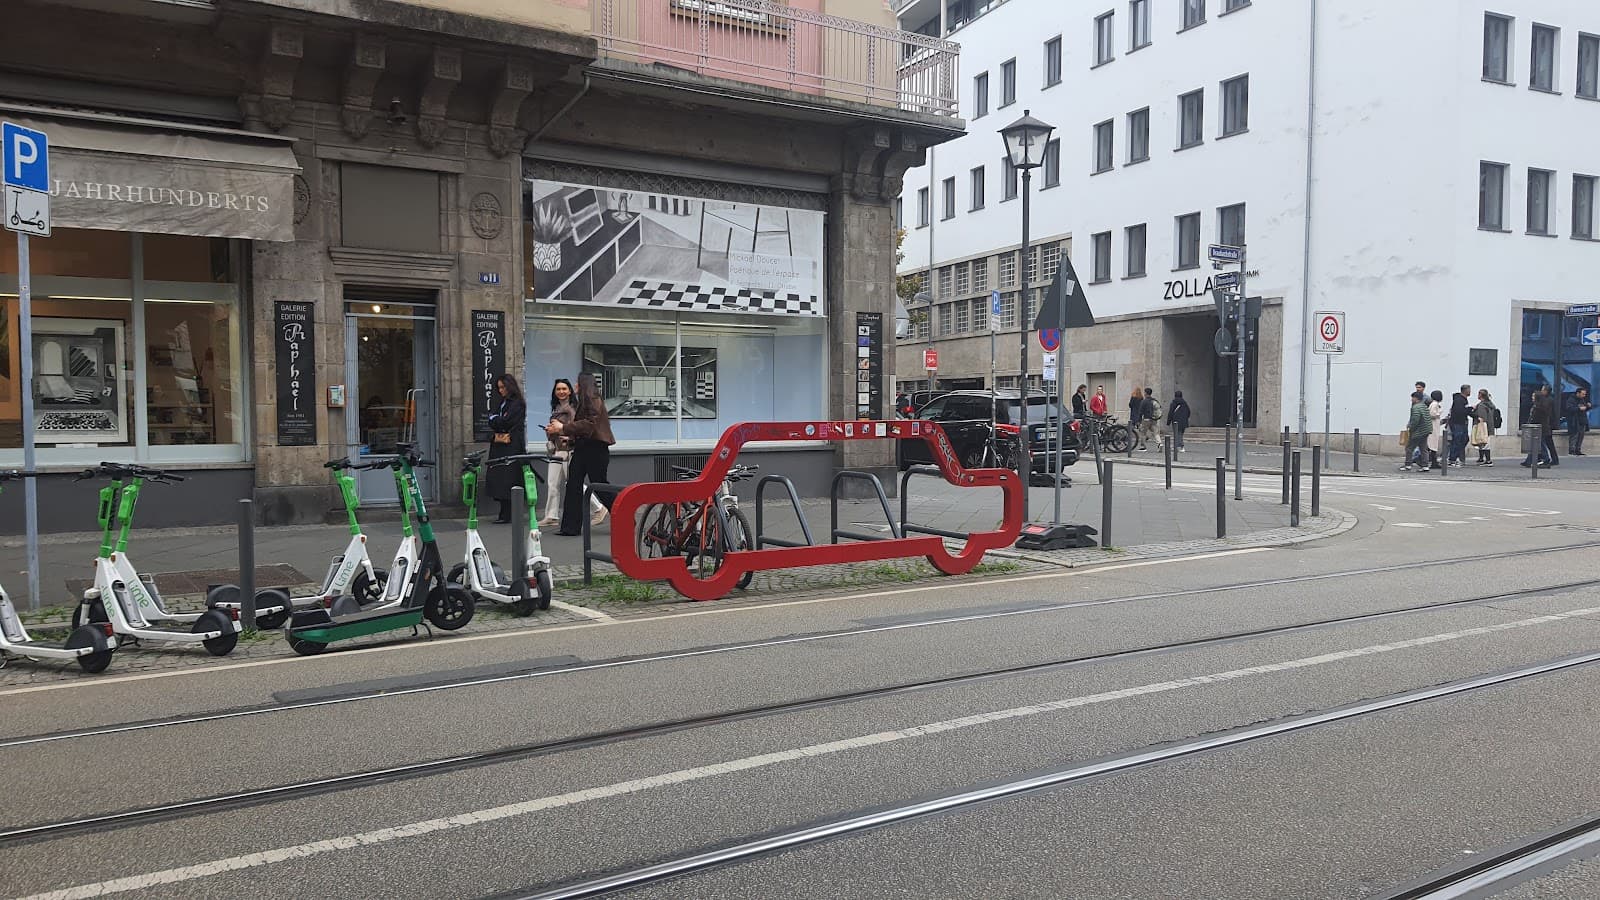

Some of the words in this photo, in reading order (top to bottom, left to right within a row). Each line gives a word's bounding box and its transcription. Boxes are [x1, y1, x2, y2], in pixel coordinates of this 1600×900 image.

[14, 133, 38, 179] P
[50, 179, 269, 212] JAHRHUNDERTS
[280, 304, 307, 312] GALERIE
[280, 313, 306, 321] EDITION
[476, 313, 499, 321] GALERIE
[476, 321, 498, 329] EDITION
[1325, 322, 1336, 335] 20
[1322, 342, 1337, 350] ZONE
